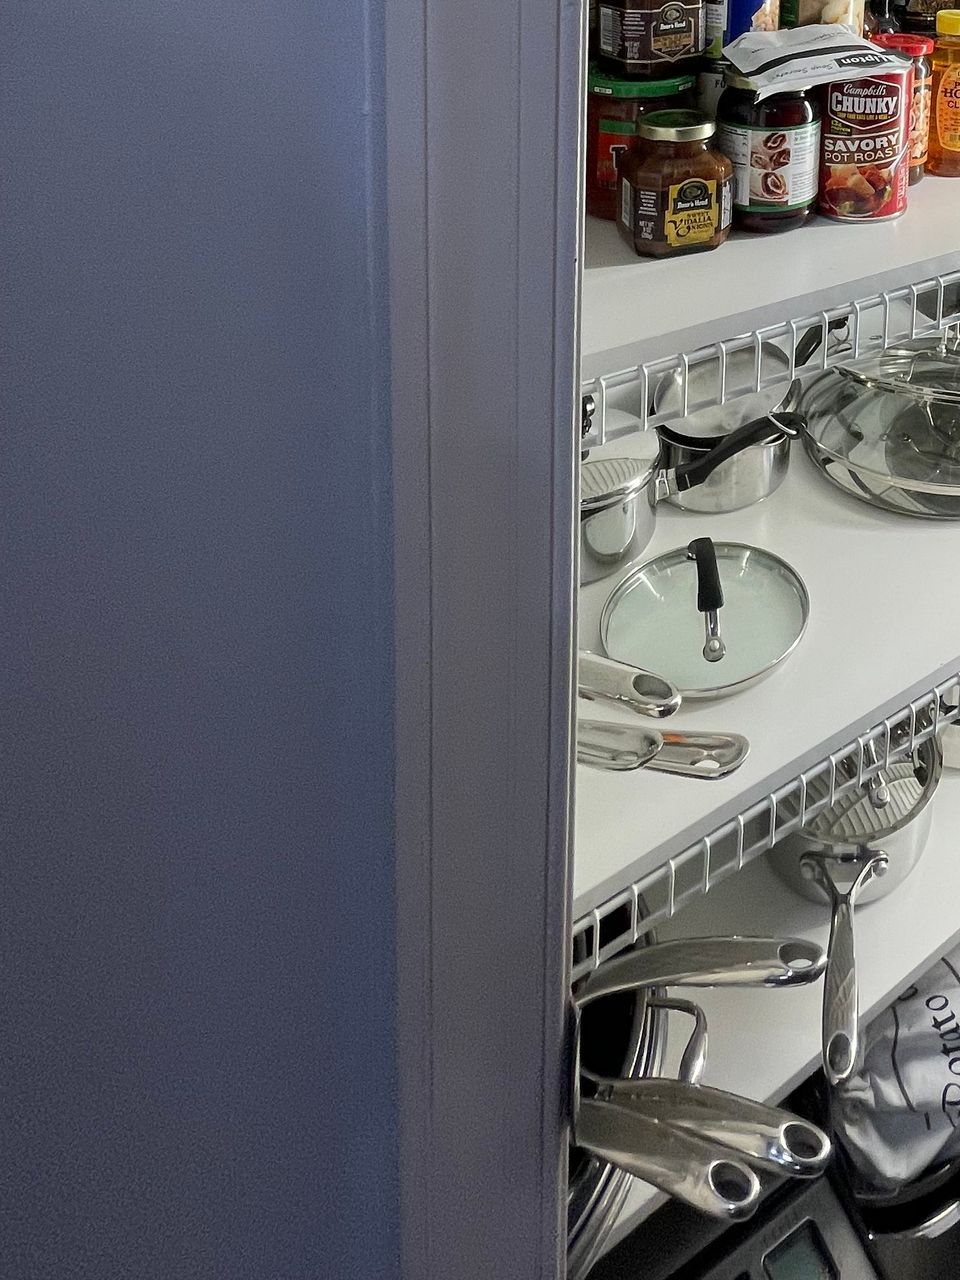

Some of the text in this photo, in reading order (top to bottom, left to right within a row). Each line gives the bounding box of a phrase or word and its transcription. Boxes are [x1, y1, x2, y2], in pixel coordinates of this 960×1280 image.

[841, 54, 895, 66] Lipton
[843, 83, 887, 97] Campbell's
[831, 92, 898, 115] CHUNKY
[824, 132, 899, 152] SAVORY
[824, 146, 900, 162] POT ROAST
